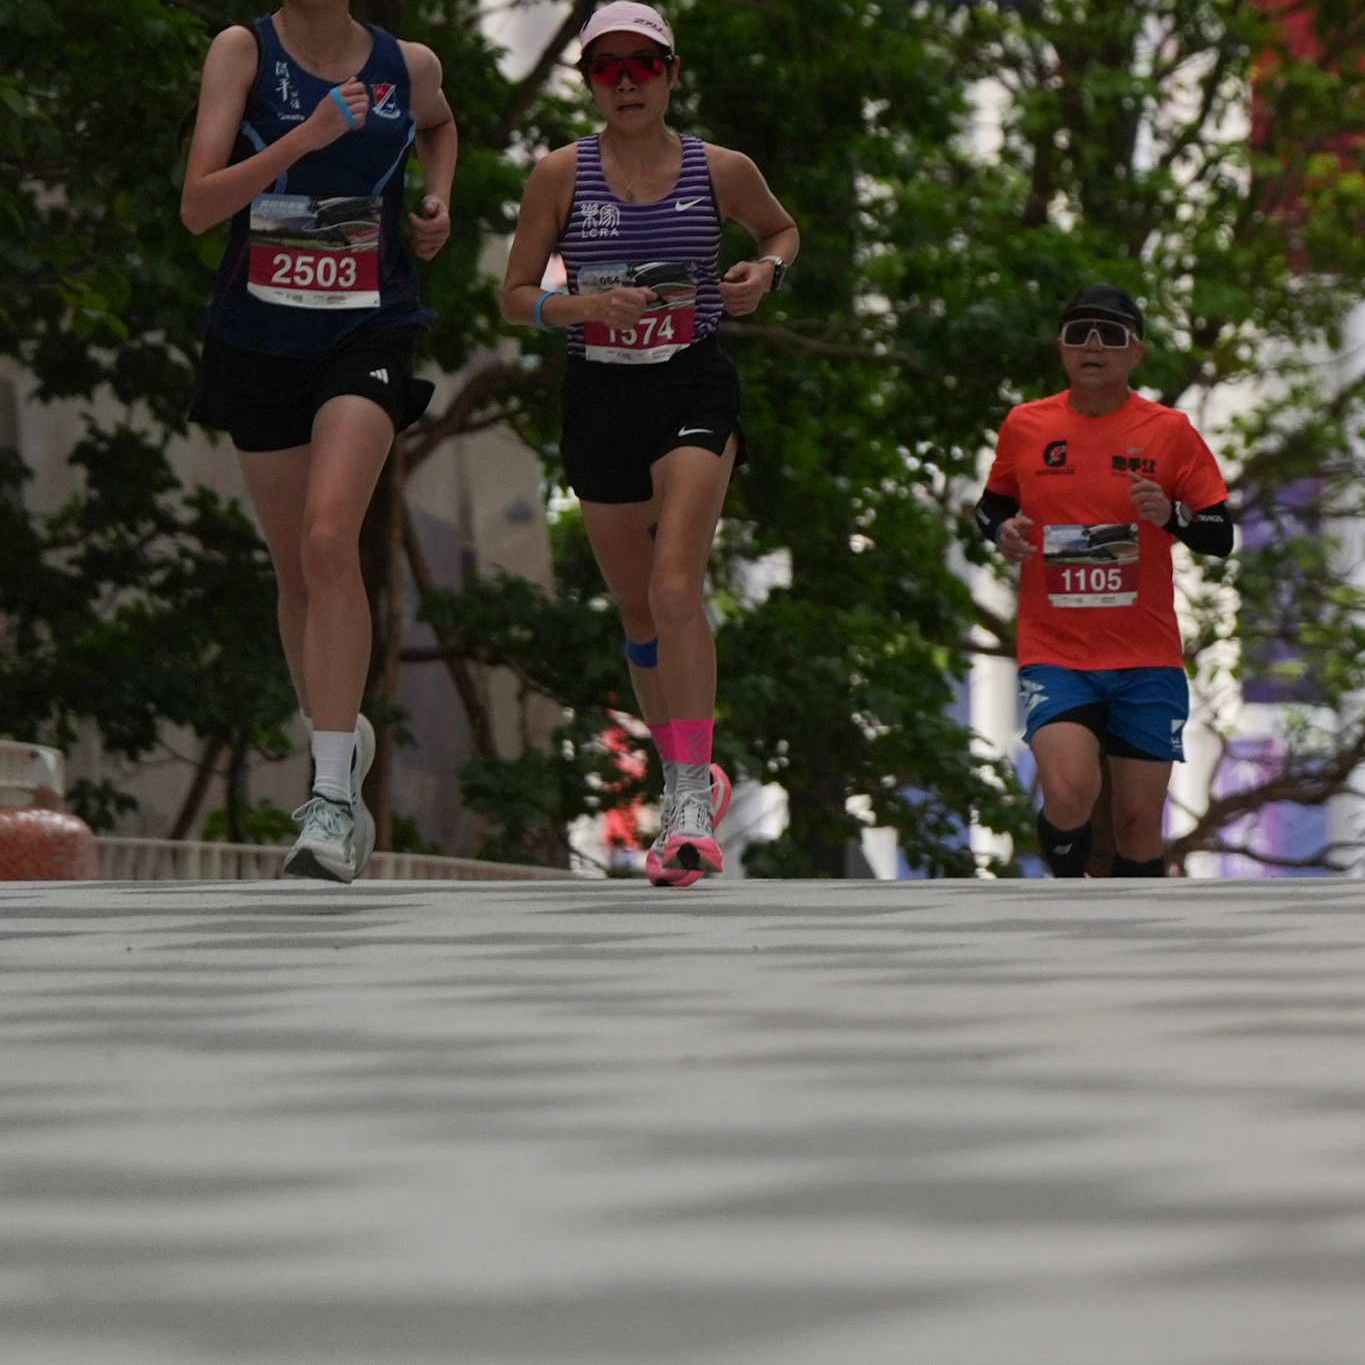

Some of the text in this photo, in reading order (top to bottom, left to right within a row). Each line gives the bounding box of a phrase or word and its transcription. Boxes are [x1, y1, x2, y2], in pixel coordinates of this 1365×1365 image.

[581, 227, 620, 239] LCRA
[271, 253, 357, 288] 2503
[1061, 568, 1123, 591] 1105
